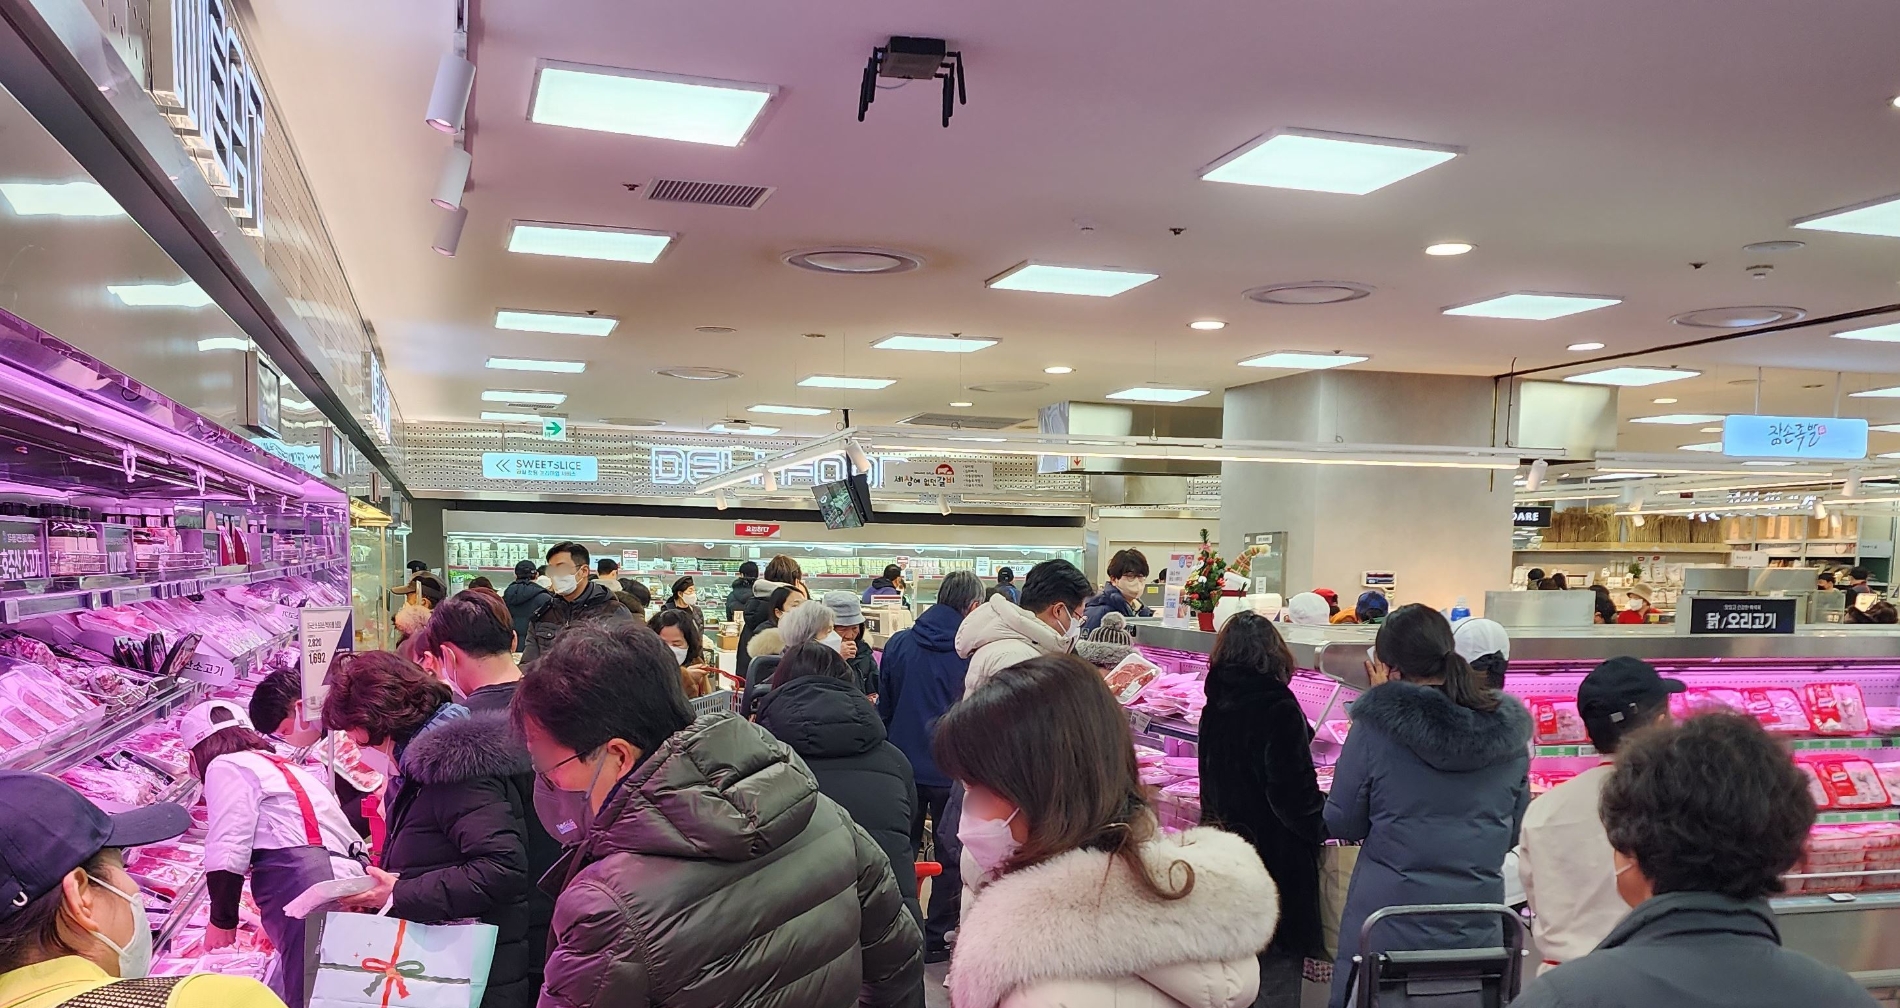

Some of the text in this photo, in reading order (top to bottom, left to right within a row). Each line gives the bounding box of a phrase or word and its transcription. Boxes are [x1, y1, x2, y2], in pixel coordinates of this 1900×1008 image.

[516, 459, 581, 471] SWEETSLICE
[894, 475, 921, 487] 세상에
[1706, 611, 1777, 629] 닭/오리고기
[308, 652, 326, 665] 1,692
